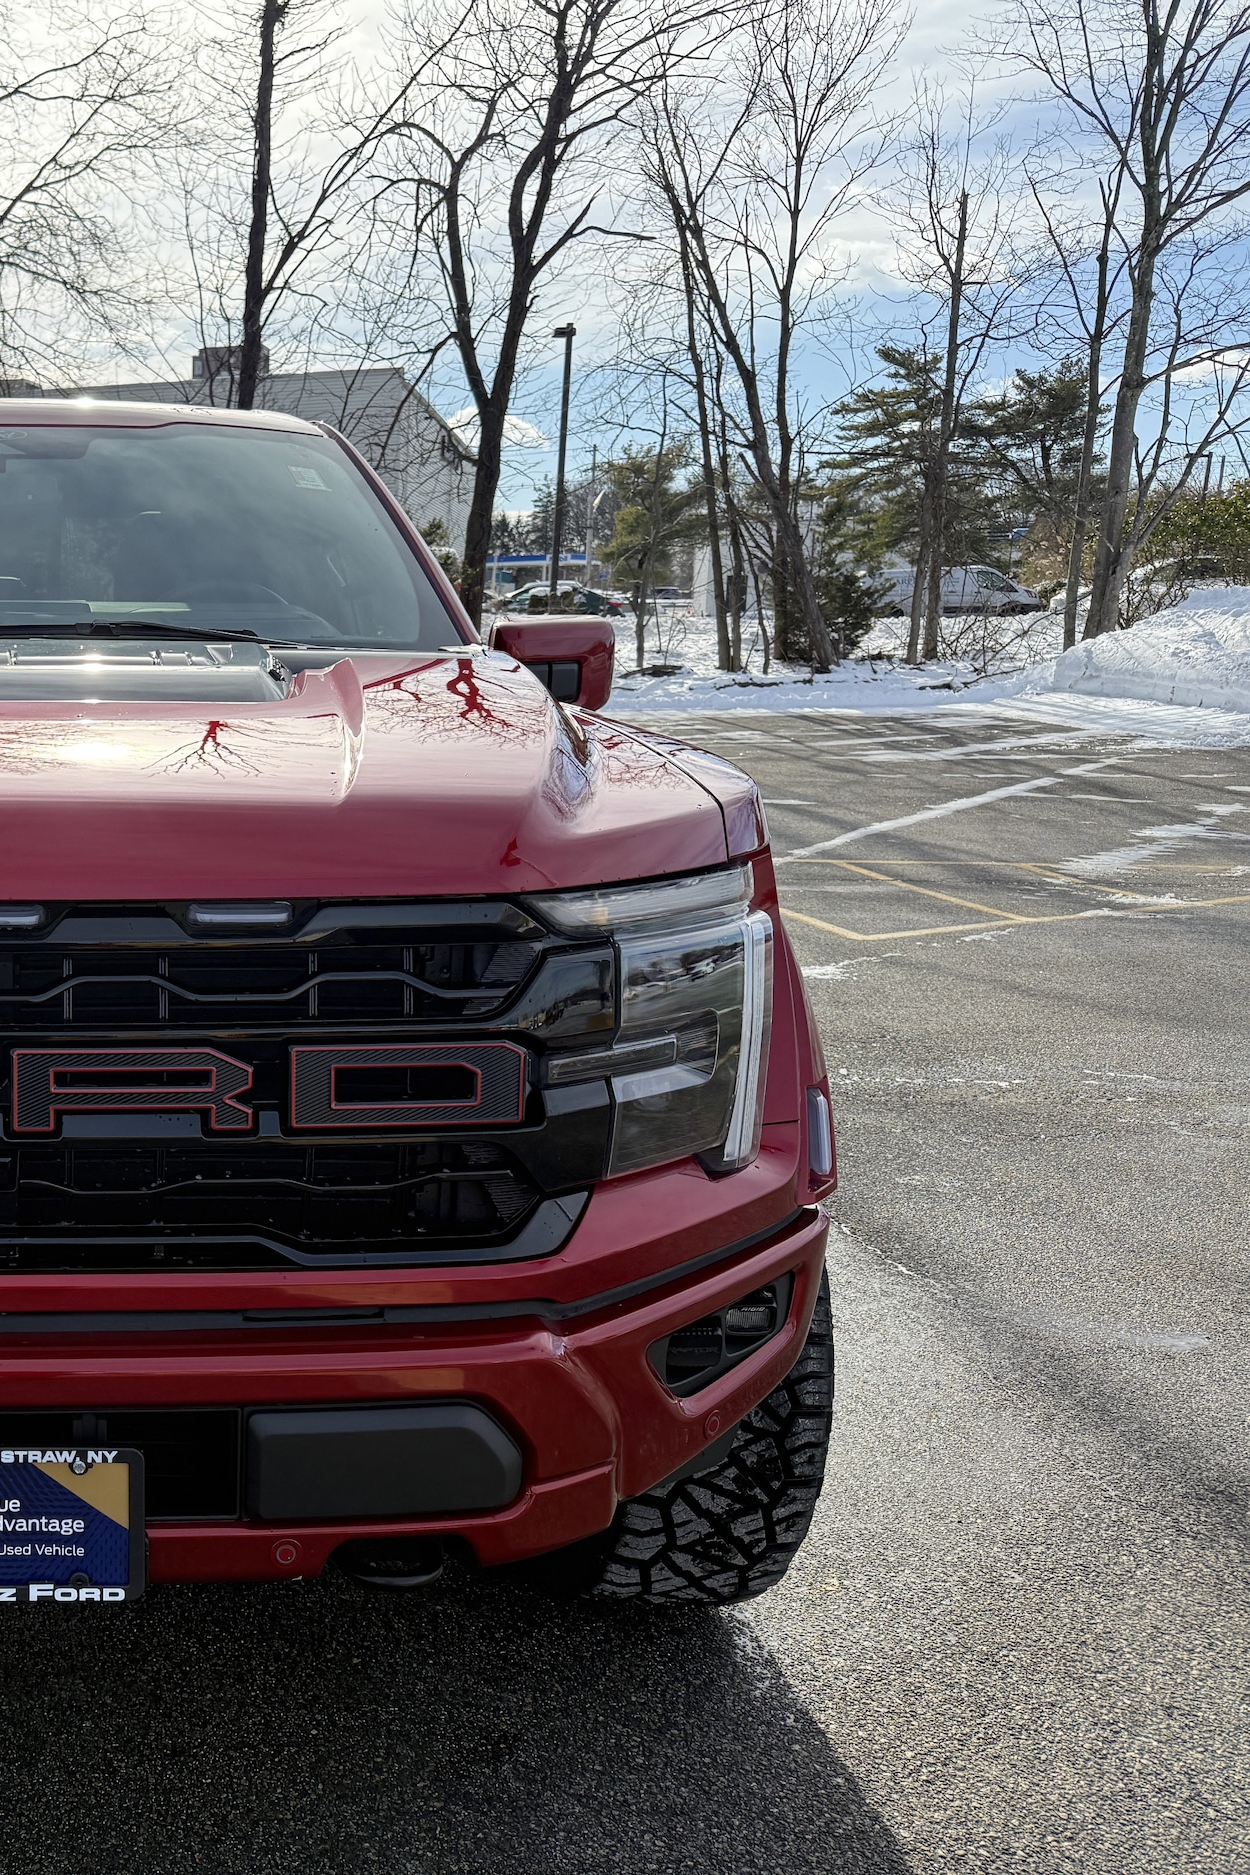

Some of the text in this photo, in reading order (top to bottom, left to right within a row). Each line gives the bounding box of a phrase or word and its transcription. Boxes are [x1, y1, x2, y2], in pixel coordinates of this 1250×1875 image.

[87, 1450, 118, 1464] NY
[34, 1543, 85, 1557] Vehicle
[28, 1583, 126, 1602] FORD
